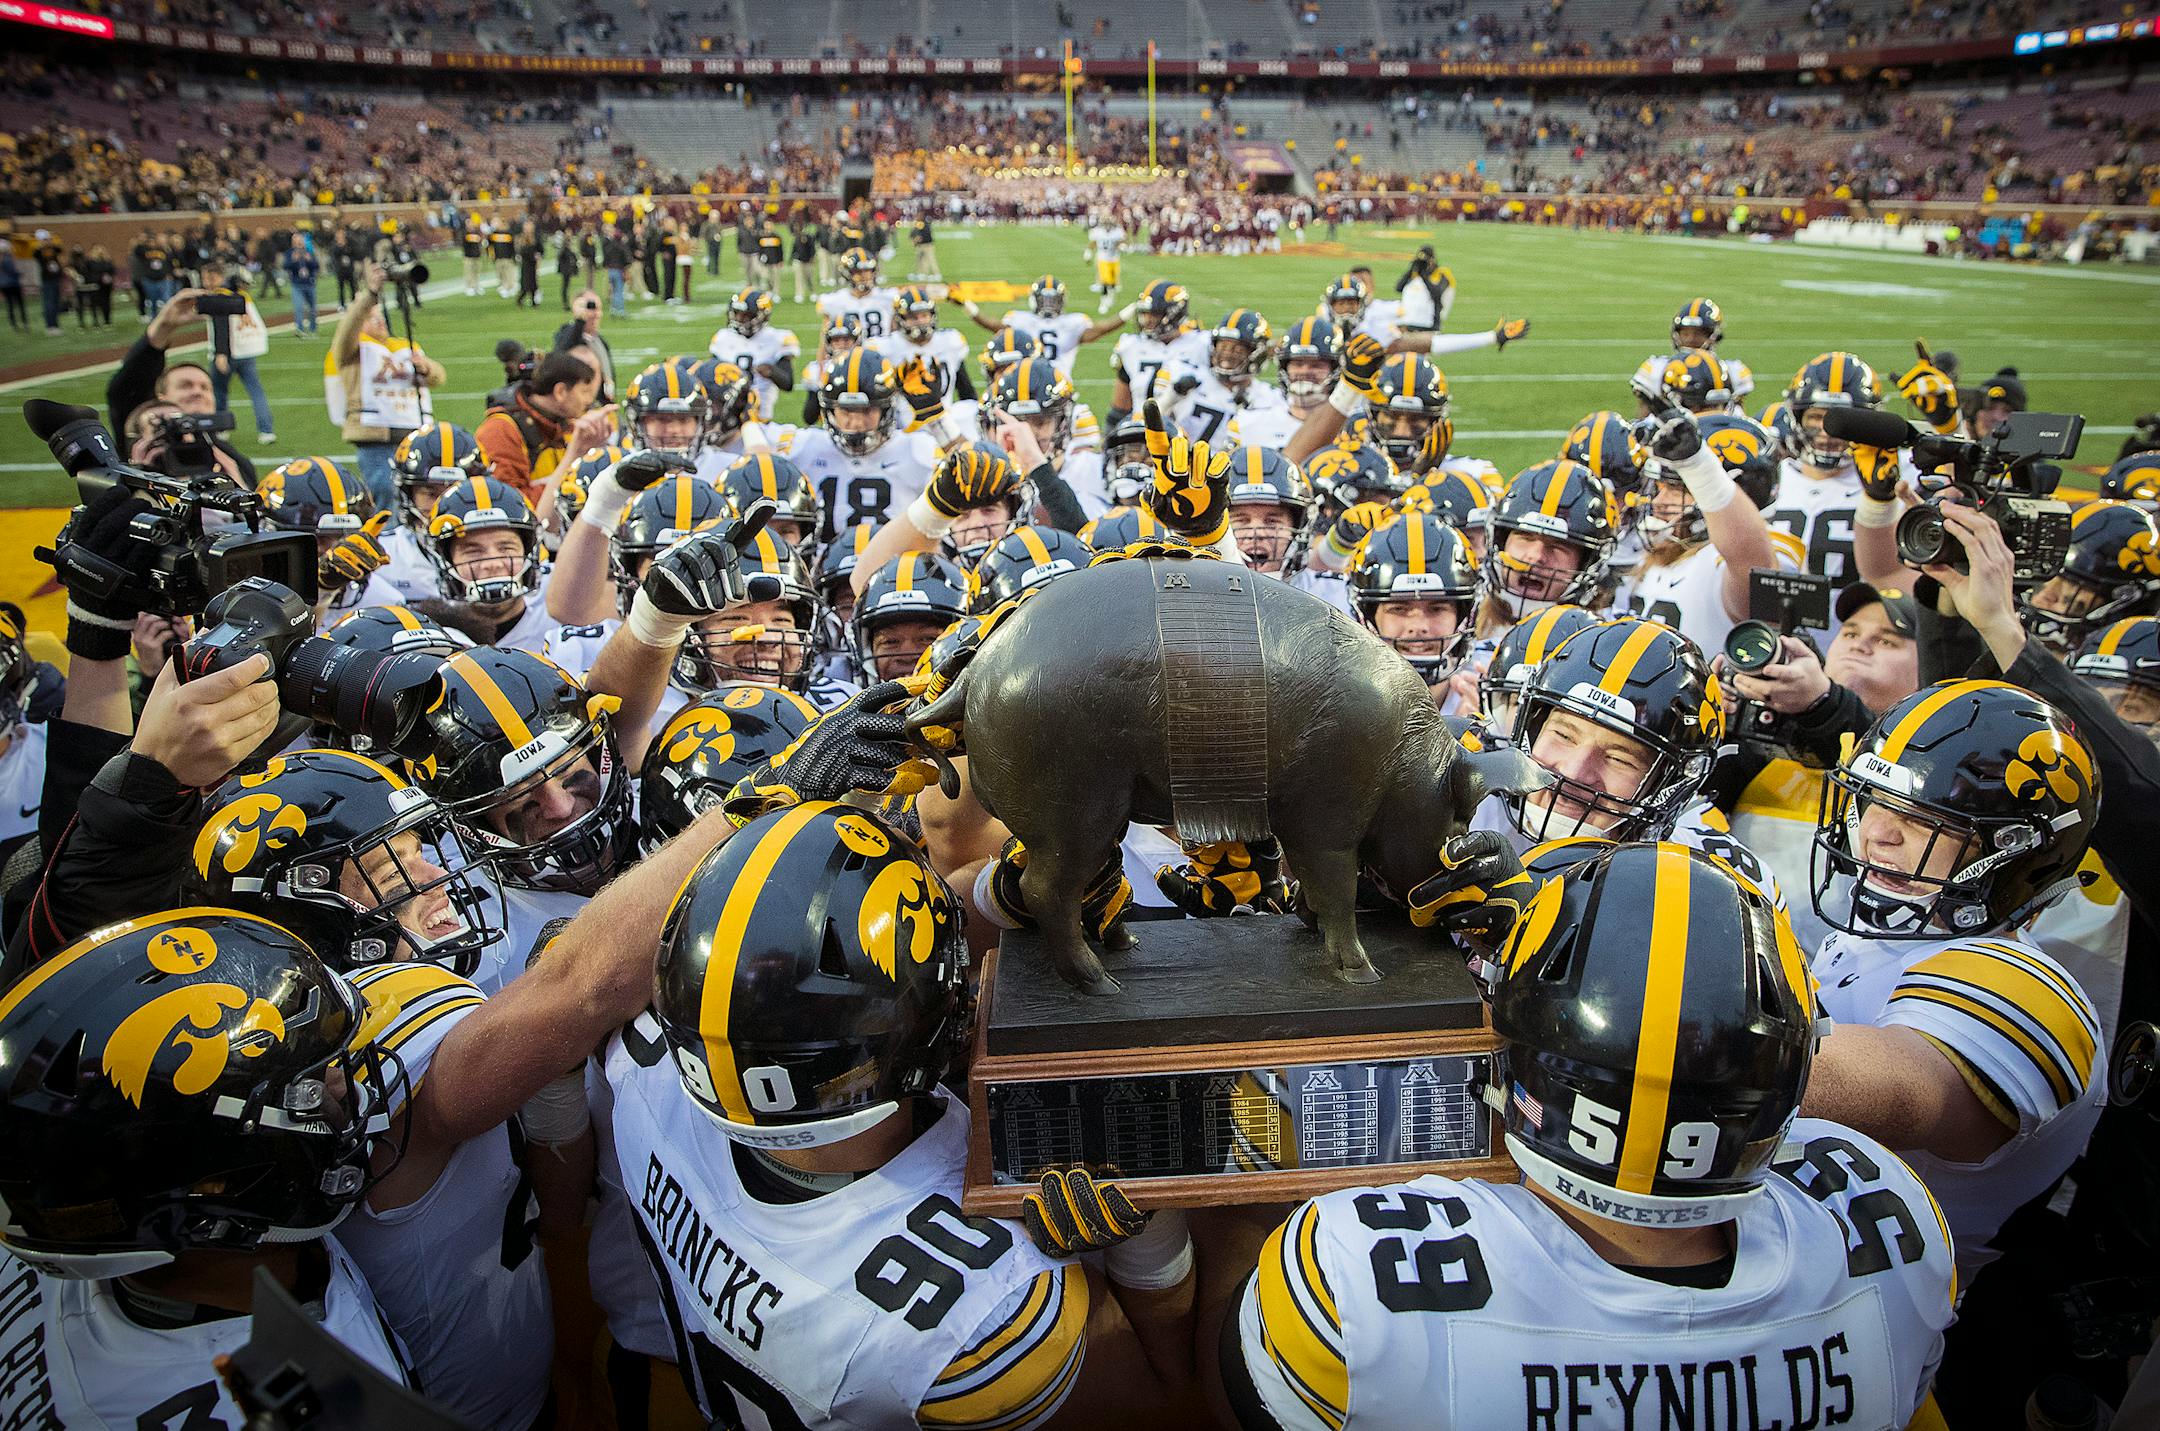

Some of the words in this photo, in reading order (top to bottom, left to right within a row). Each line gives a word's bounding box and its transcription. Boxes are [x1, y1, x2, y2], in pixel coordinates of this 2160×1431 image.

[816, 476, 891, 544] 18
[67, 558, 105, 584] Panasonic
[1035, 562, 1059, 576] IOWA
[1164, 572, 1191, 589] M
[1406, 576, 1427, 584] IOWA
[1760, 577, 1786, 588] RED
[1790, 581, 1817, 593] PRO
[892, 591, 913, 601] IOWA
[290, 609, 309, 628] Canon
[407, 629, 431, 637] IOWA
[1586, 688, 1617, 710] IOWA
[514, 740, 547, 764] IOWA
[1865, 757, 1892, 779] IOWA
[837, 821, 886, 849] ANF
[160, 933, 207, 967] ANF
[1302, 1070, 1342, 1091] M
[1365, 1066, 1378, 1088] I
[1400, 1063, 1440, 1086] M
[1463, 1060, 1476, 1082] I
[1203, 1076, 1243, 1097] M
[1266, 1072, 1279, 1094] I
[1430, 1087, 1446, 1095] 1998
[1234, 1100, 1250, 1108] 1984
[1430, 1096, 1446, 1104] 1999
[1270, 1107, 1277, 1115] 31
[1306, 1114, 1311, 1122] 3
[1332, 1112, 1348, 1120] 1993
[1368, 1110, 1376, 1118] 21
[1234, 1118, 1250, 1126] 1986
[1270, 1116, 1278, 1124] 30
[1304, 1123, 1313, 1131] 42
[1368, 1119, 1376, 1127] 49
[1402, 1117, 1411, 1125] 24
[1402, 1126, 1411, 1134] 21
[1430, 1124, 1446, 1132] 2002
[1234, 1127, 1250, 1135] 1987
[1430, 1133, 1446, 1141] 2003
[1465, 1131, 1474, 1139] 40
[773, 1159, 818, 1185] COMBAT
[1554, 1174, 1709, 1224] HAWKEYES
[642, 1150, 784, 1353] BRINCKS
[1352, 1192, 1494, 1312] 59
[854, 1192, 1014, 1332] 90
[1521, 1332, 1856, 1431] REYNOLDS
